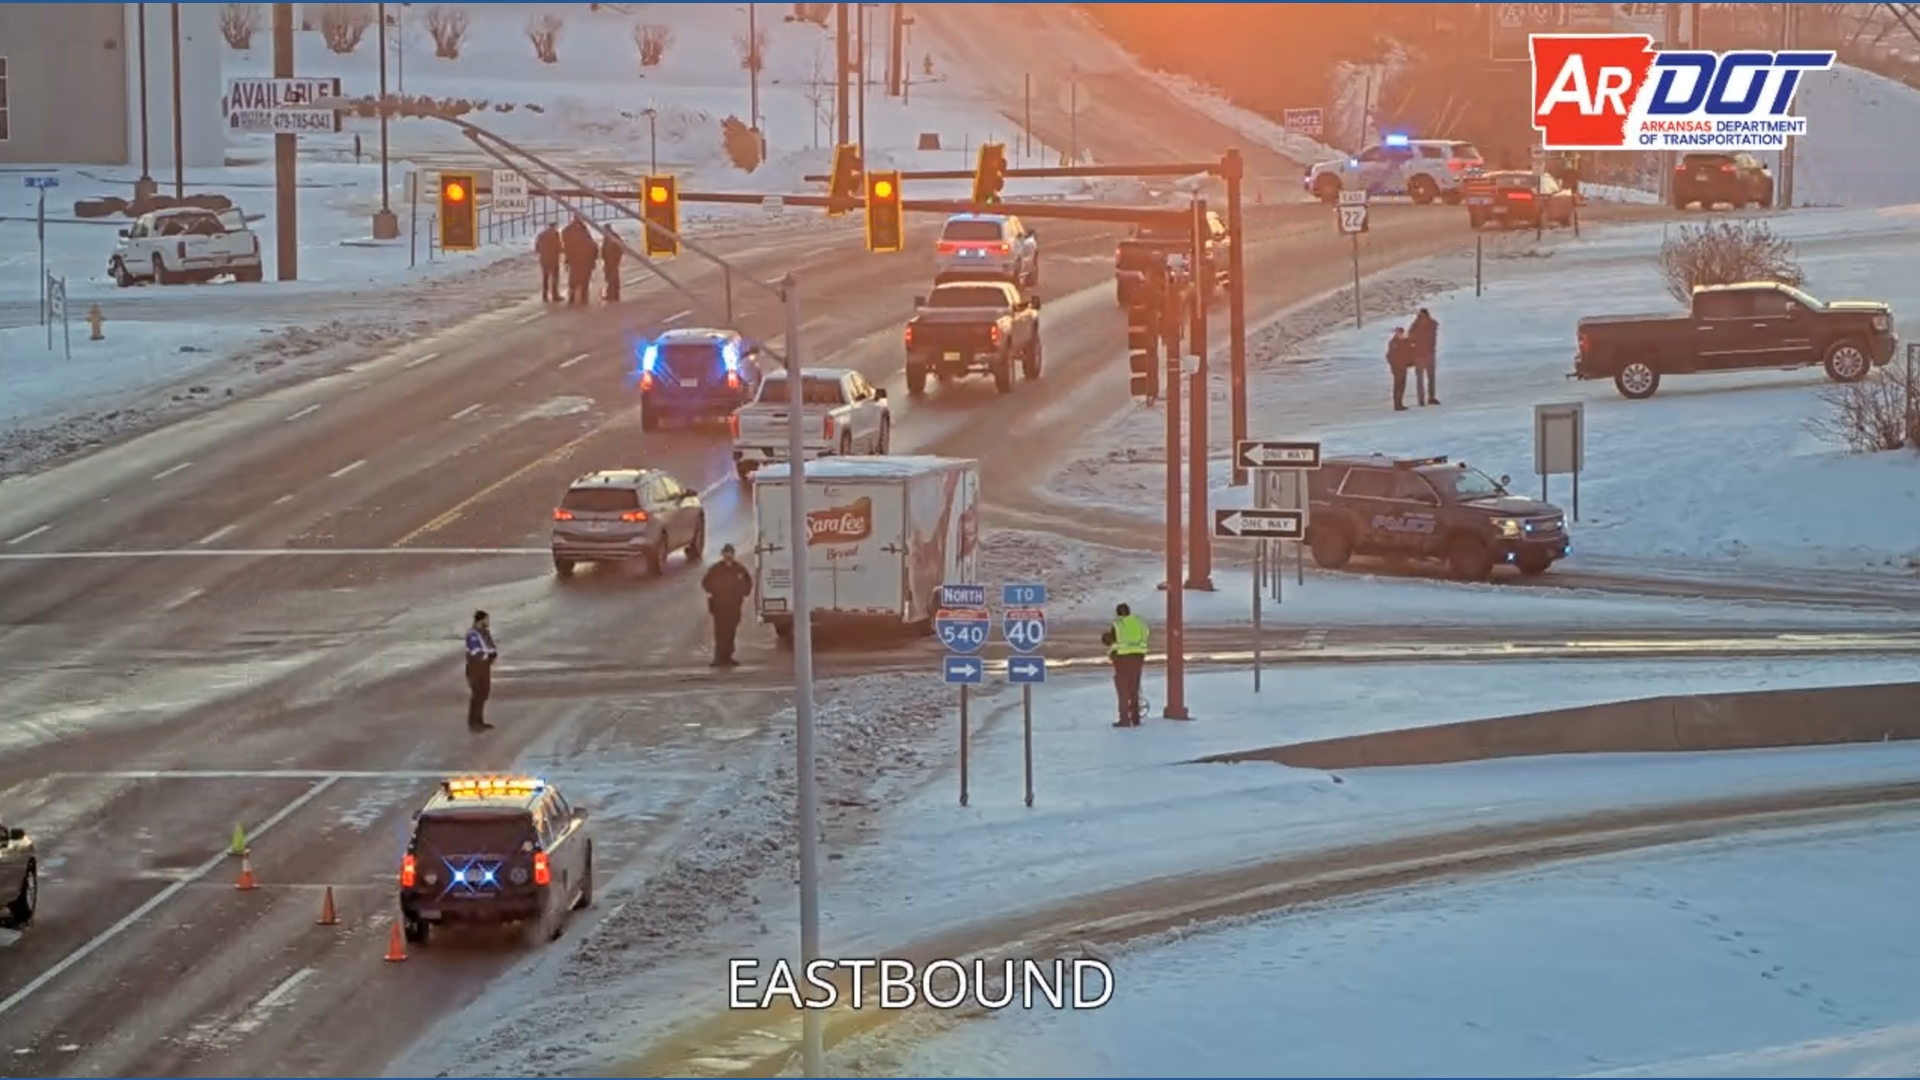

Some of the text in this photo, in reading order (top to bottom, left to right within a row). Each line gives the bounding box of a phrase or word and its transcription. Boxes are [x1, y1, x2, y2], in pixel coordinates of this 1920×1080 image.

[1344, 211, 1361, 227] 22
[1263, 451, 1308, 459] ONE WAY
[1242, 519, 1289, 528] ONE WAY
[944, 588, 982, 602] NORTH
[1014, 588, 1034, 601] TO
[944, 626, 983, 643] 540
[1009, 620, 1043, 643] 40
